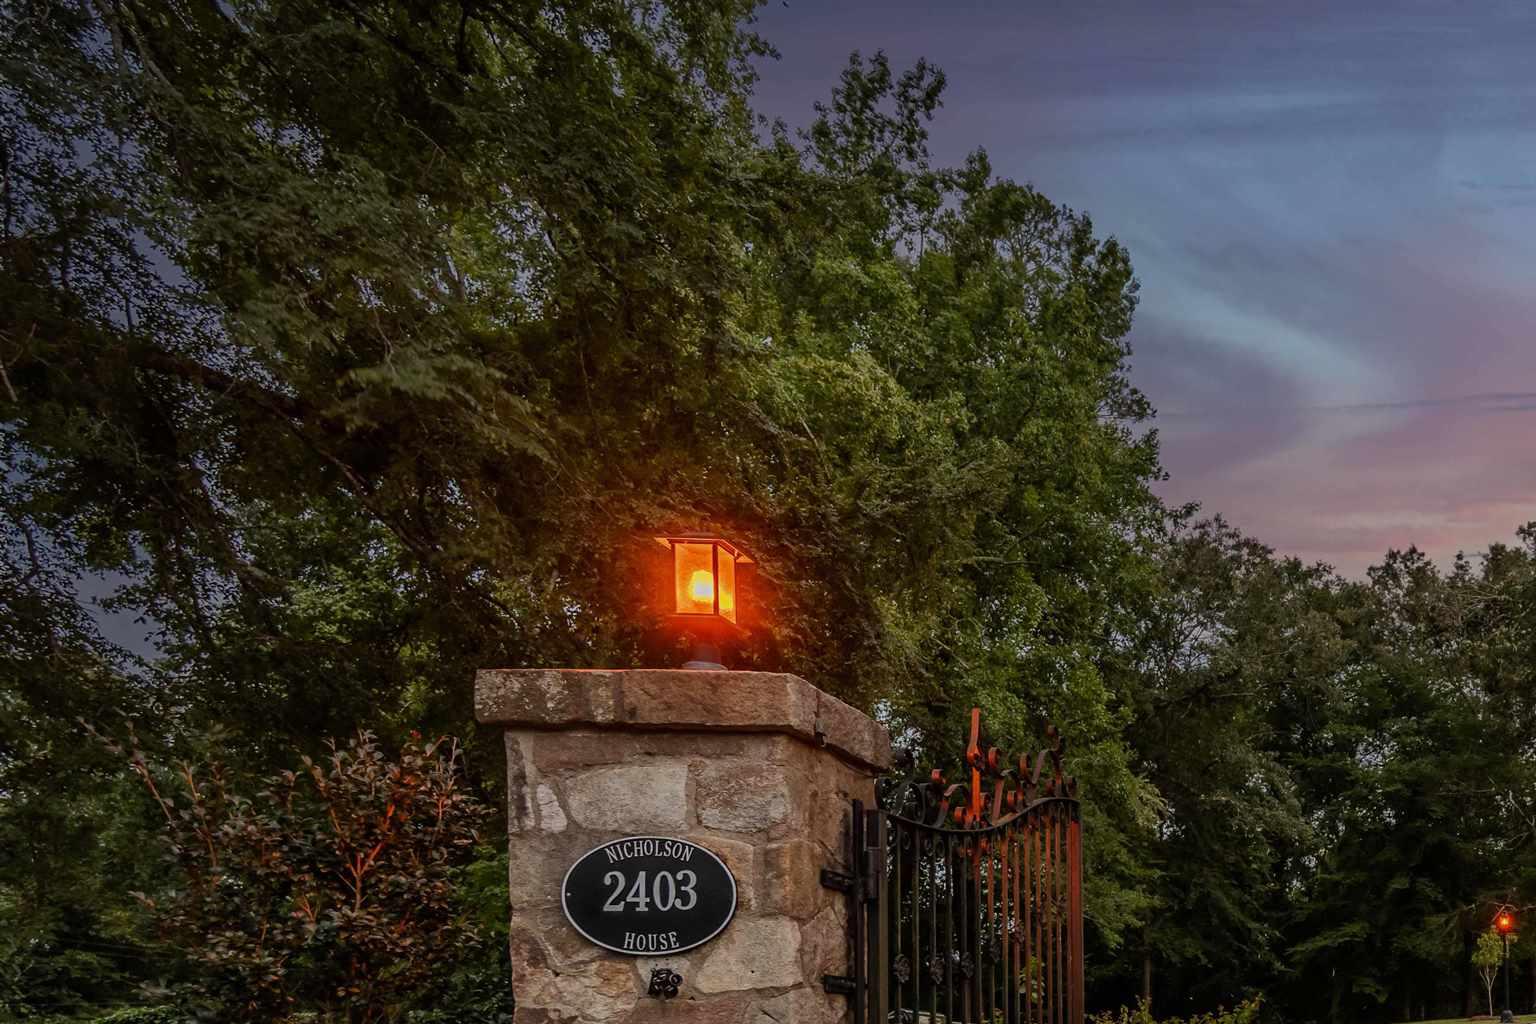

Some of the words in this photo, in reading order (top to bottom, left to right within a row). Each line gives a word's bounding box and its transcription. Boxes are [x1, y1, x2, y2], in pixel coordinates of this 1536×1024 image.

[605, 839, 695, 864] NICHOLSON
[602, 869, 698, 912] 2403
[623, 931, 680, 951] HOUSE
